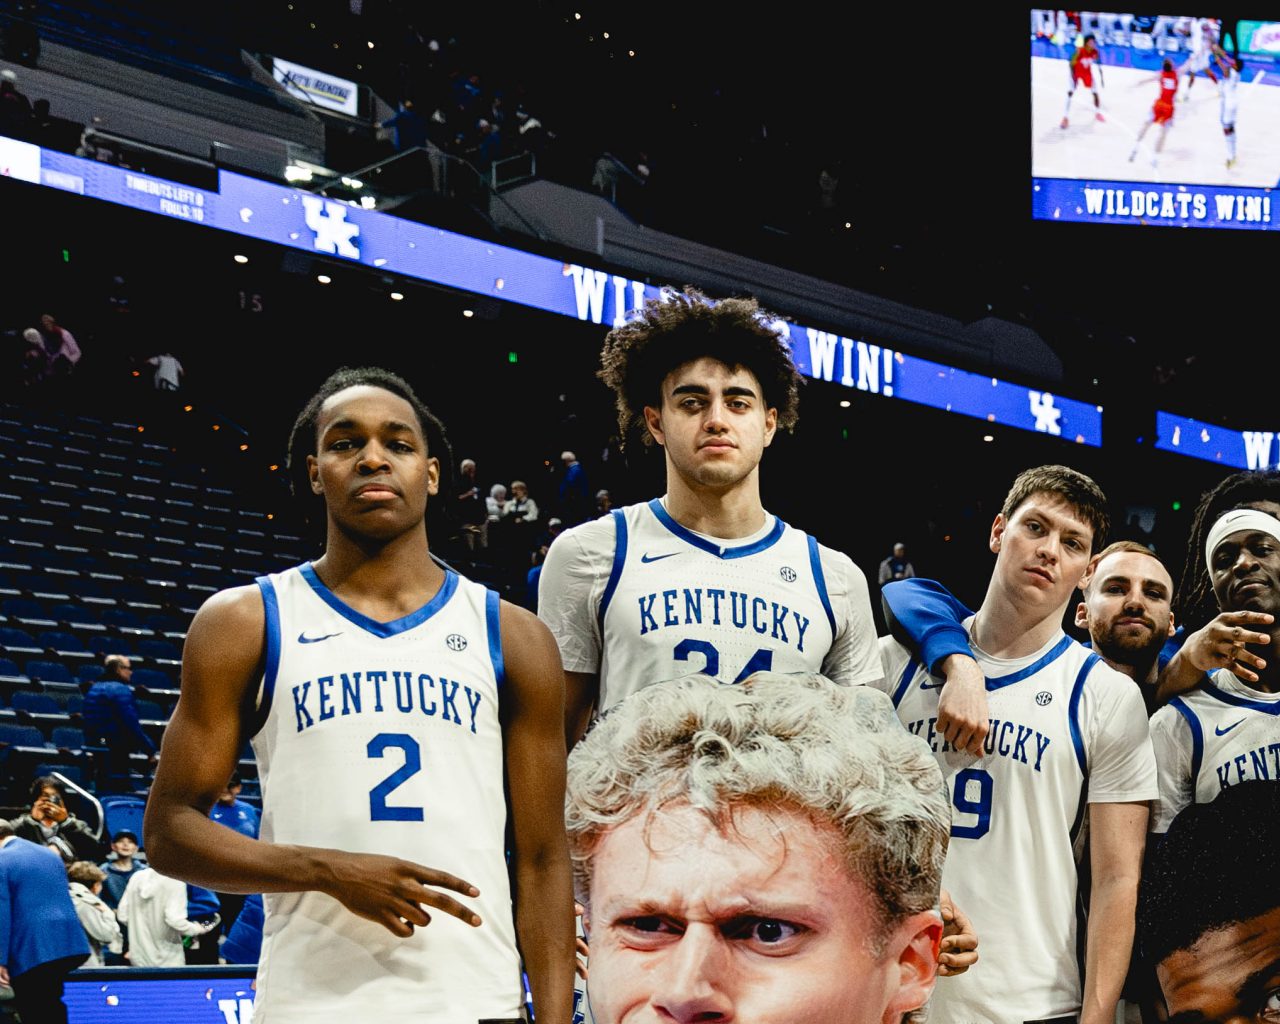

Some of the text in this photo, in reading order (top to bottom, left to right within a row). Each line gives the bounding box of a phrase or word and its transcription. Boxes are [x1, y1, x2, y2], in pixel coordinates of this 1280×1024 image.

[1085, 188, 1271, 223] WILDCATS WIN!
[806, 327, 894, 397] WIN!
[638, 588, 810, 652] KENTUCKY
[292, 671, 482, 734] KENTUCKY
[366, 733, 424, 822] 2
[950, 767, 994, 840] 9
